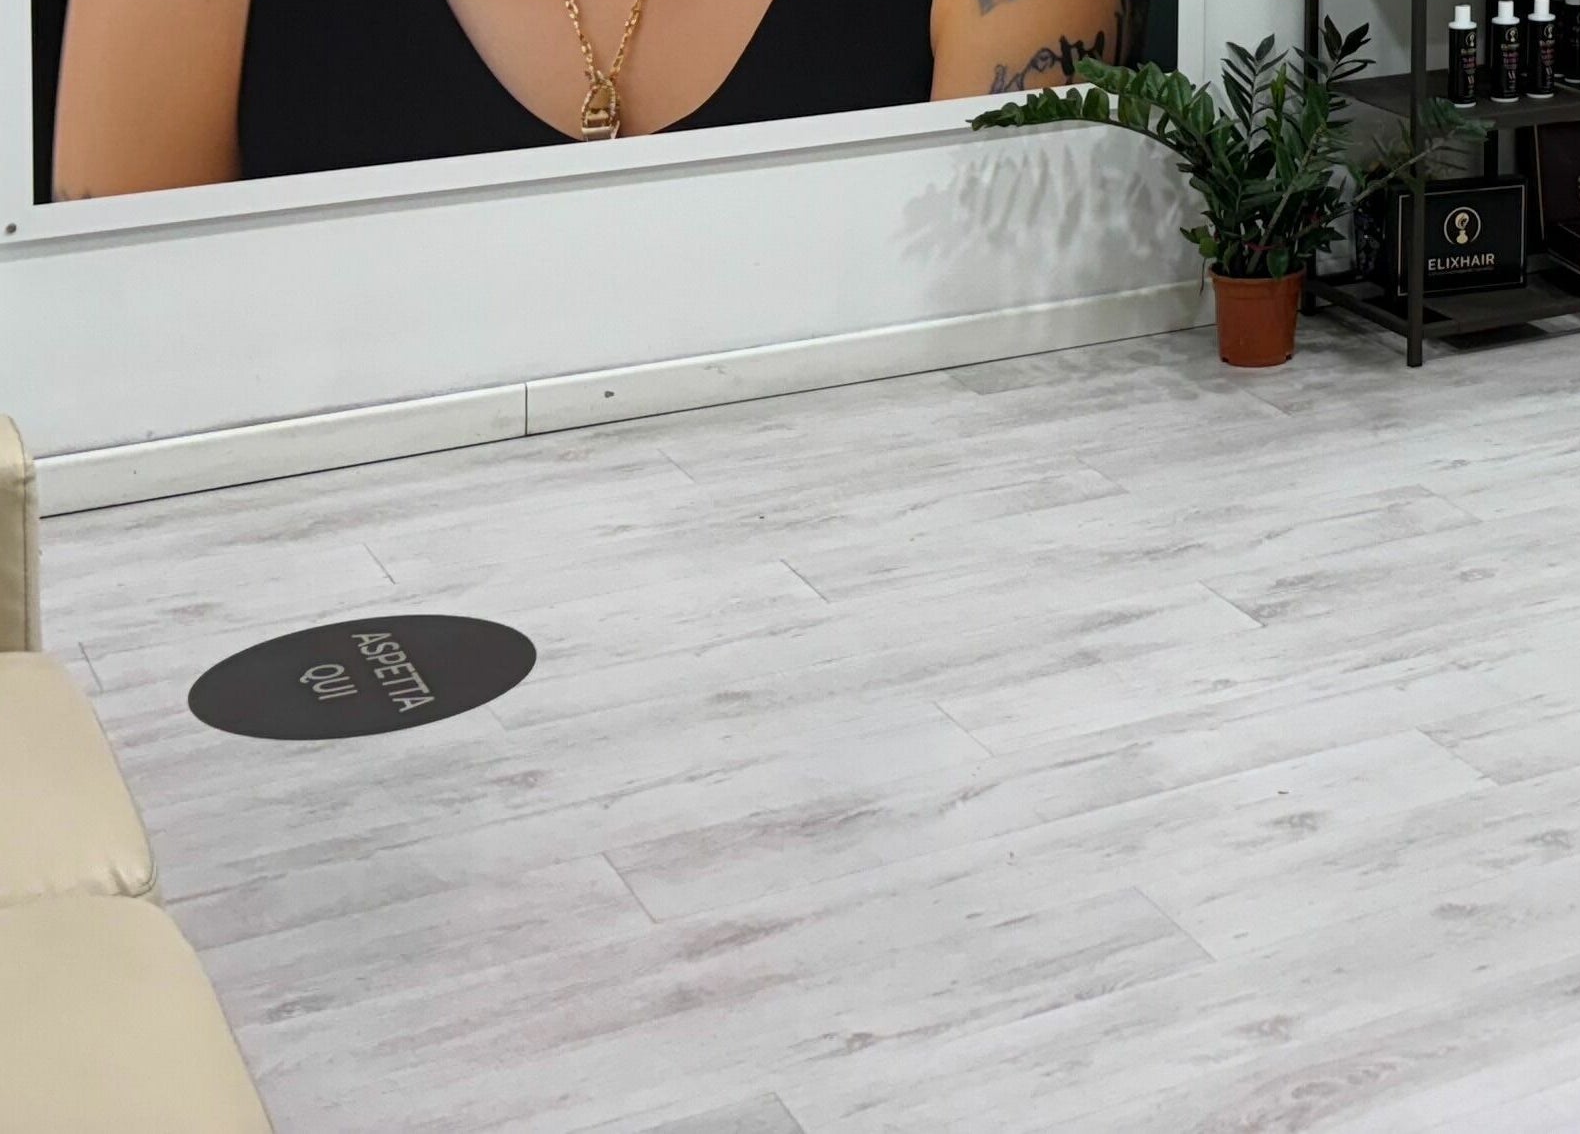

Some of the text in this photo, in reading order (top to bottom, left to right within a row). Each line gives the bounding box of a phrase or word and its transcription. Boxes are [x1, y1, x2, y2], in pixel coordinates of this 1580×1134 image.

[1428, 253, 1495, 271] ELIXHAIR
[299, 664, 358, 701] QUI
[351, 632, 435, 713] ASPETTA
